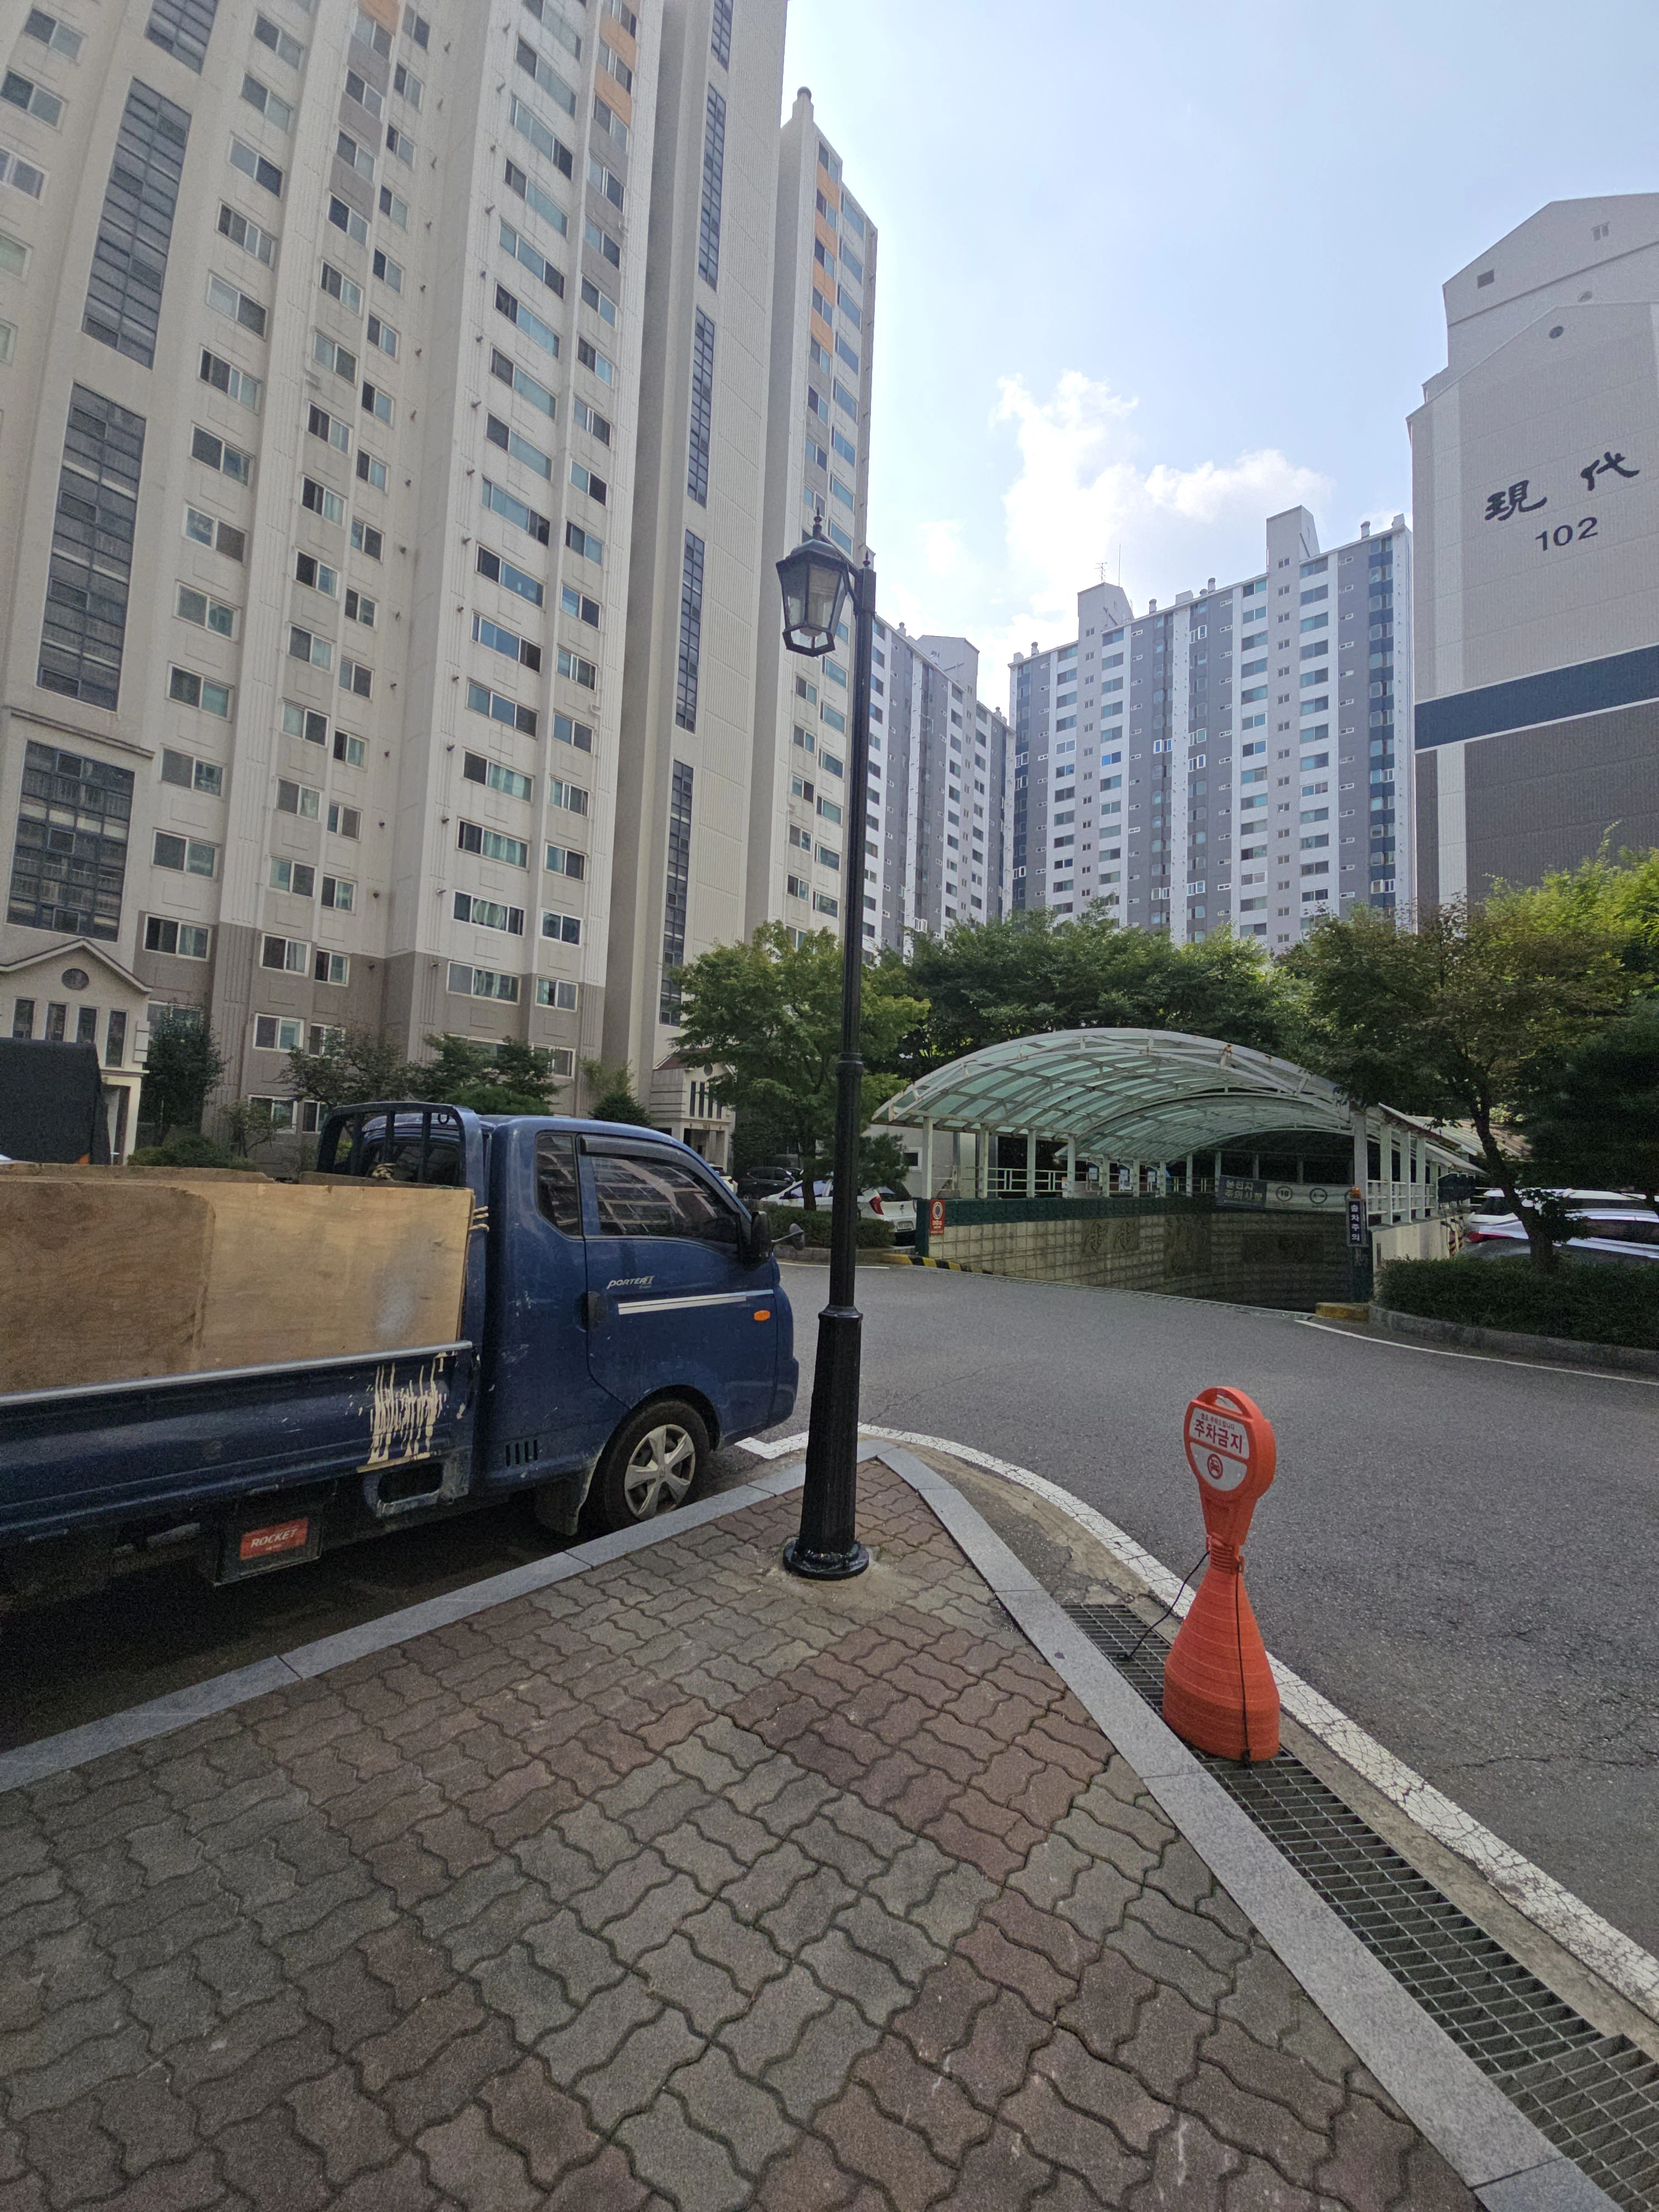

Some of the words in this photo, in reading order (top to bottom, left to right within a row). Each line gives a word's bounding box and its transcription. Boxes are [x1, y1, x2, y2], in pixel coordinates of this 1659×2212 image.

[1536, 517, 1598, 551] 102
[1194, 1419, 1243, 1454] 주차금지
[251, 1528, 298, 1548] ROCKET
